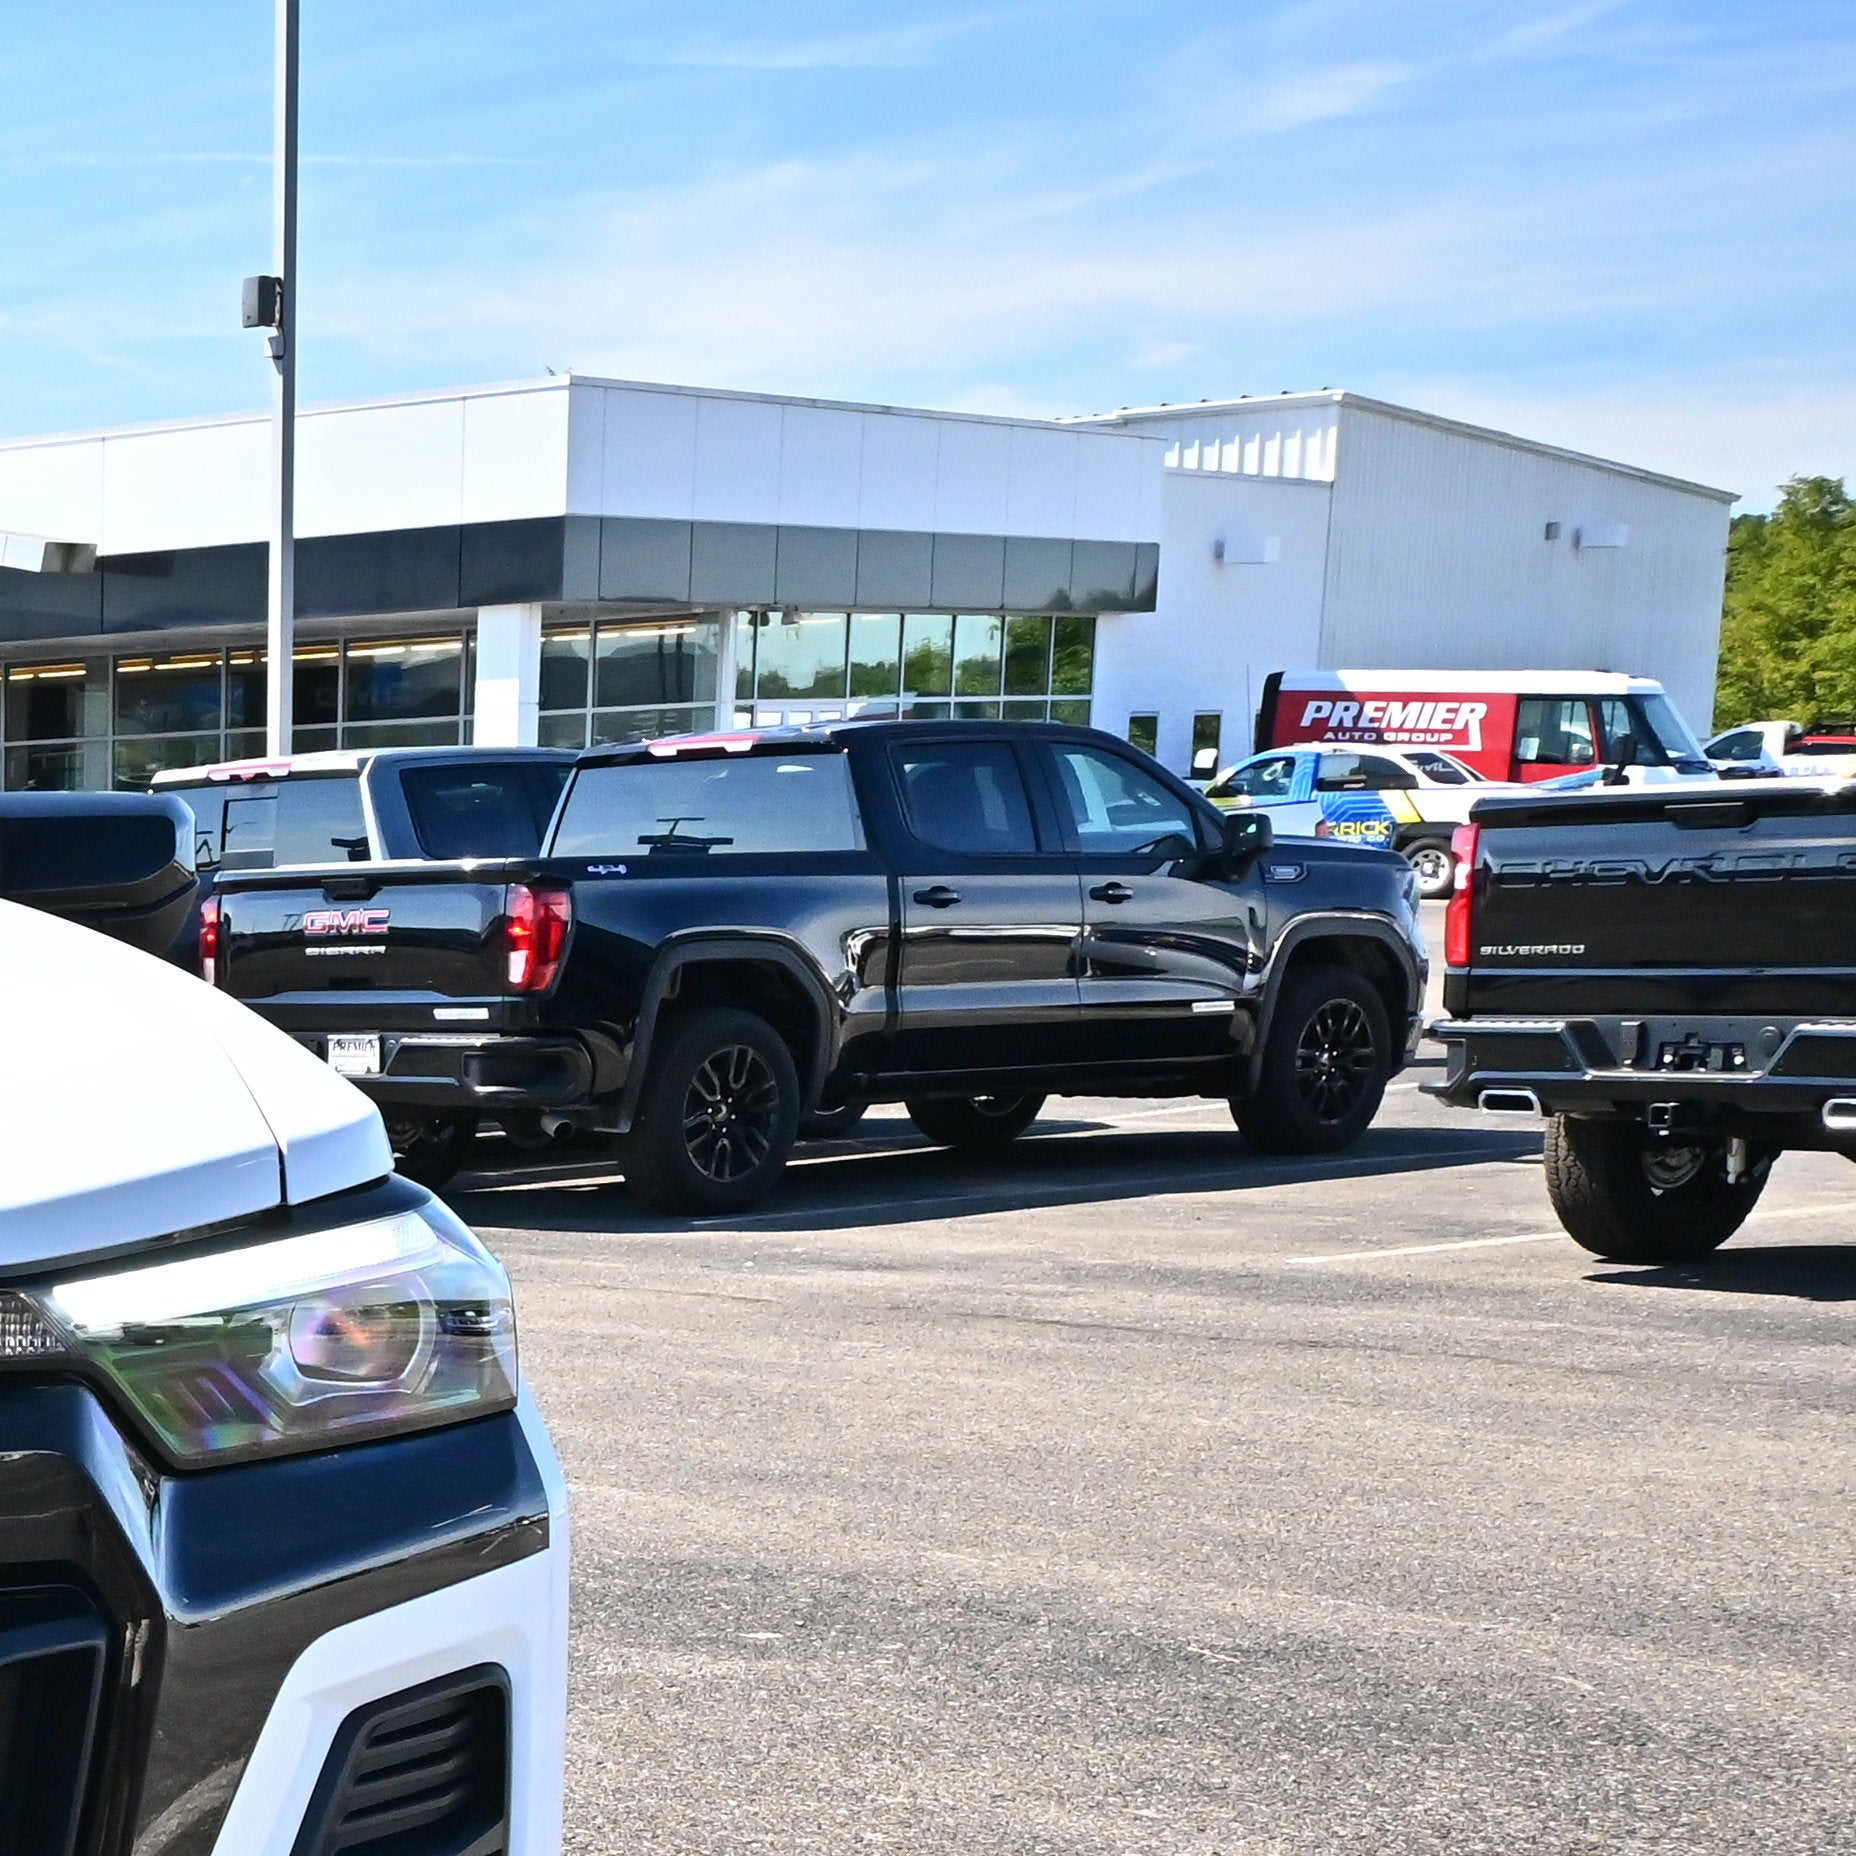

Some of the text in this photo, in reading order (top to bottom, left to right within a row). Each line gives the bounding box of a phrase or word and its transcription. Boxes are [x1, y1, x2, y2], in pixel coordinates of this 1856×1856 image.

[1299, 700, 1488, 732] PREMIER
[1323, 731, 1454, 743] AUTO GROUP
[302, 909, 390, 936] GMC
[1479, 944, 1586, 957] SILVERADO
